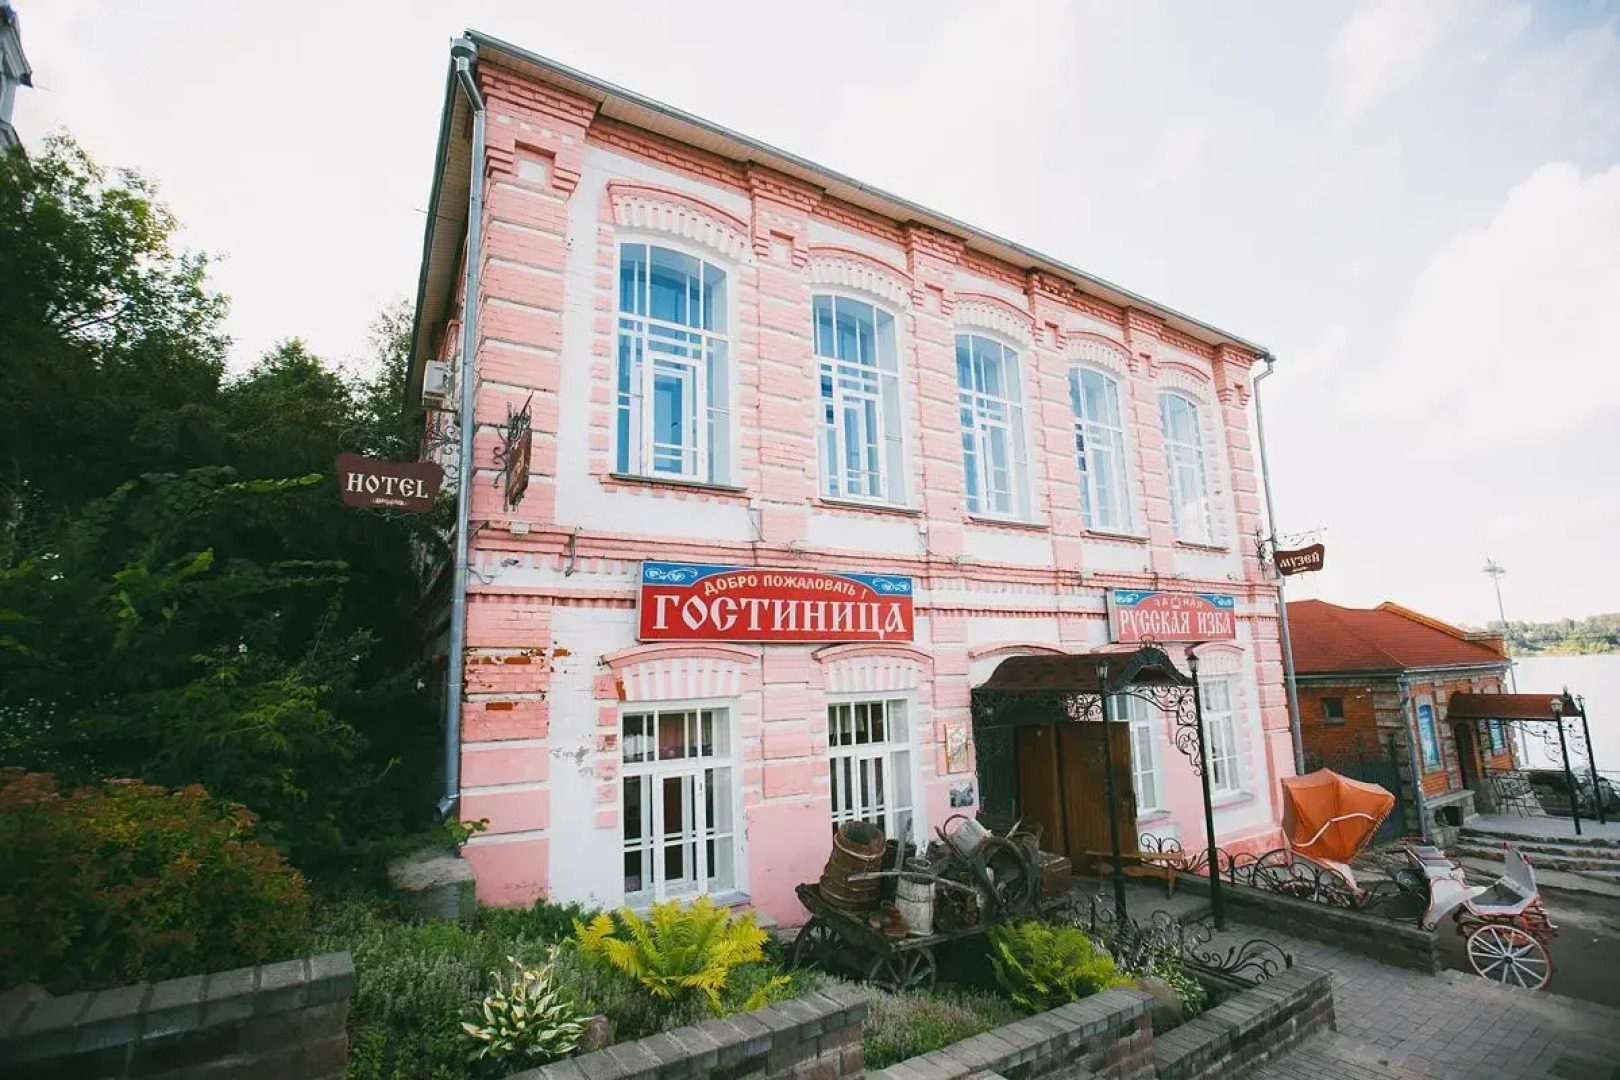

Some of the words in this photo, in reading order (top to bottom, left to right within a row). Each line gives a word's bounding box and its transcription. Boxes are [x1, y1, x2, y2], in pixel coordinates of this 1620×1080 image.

[345, 471, 429, 499] HOTEL
[703, 574, 757, 596] ДОБРО
[763, 574, 856, 597] ПОЖАЛОВАТЬ
[652, 594, 907, 640] ГОСТИНИЦА
[1119, 609, 1191, 640] РУССКАЯ
[1197, 611, 1232, 636] ИЗБА
